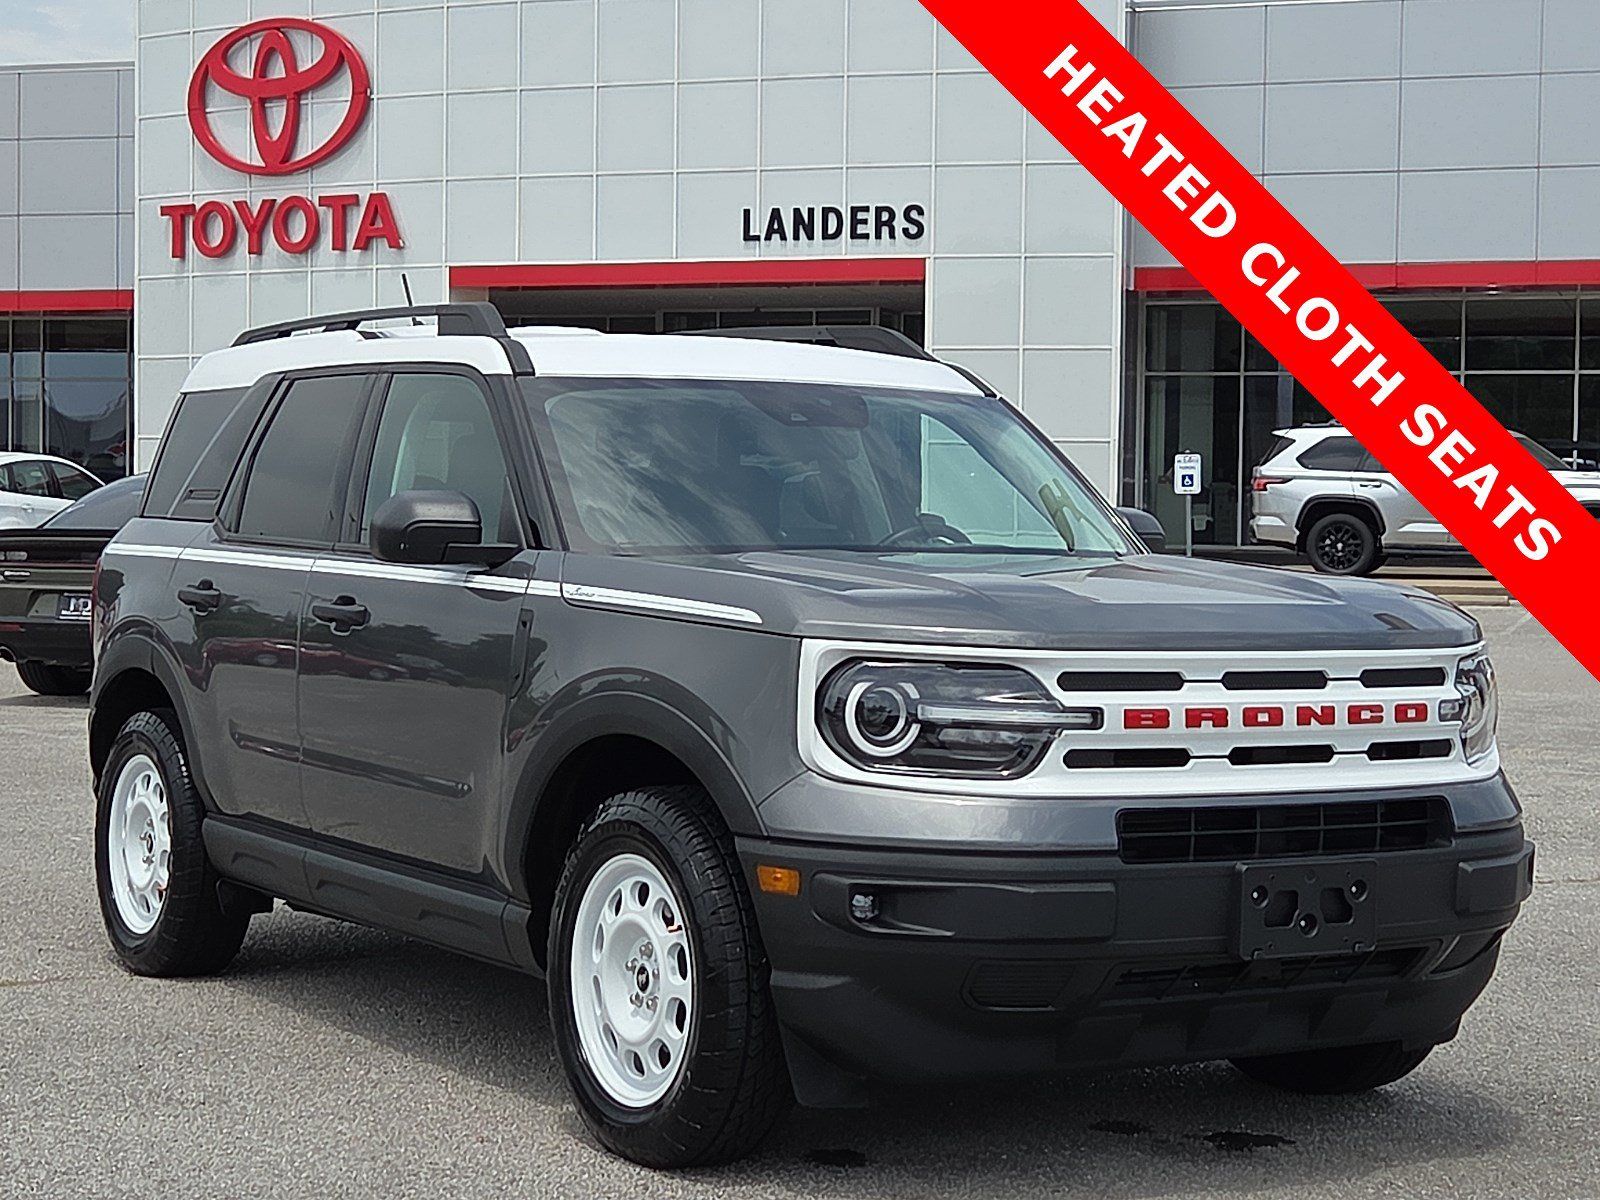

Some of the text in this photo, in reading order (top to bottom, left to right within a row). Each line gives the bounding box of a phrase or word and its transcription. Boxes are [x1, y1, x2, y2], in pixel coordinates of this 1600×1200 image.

[160, 192, 404, 258] TOYOTA
[742, 204, 925, 241] LANDERS
[1123, 702, 1428, 729] BRONCO
